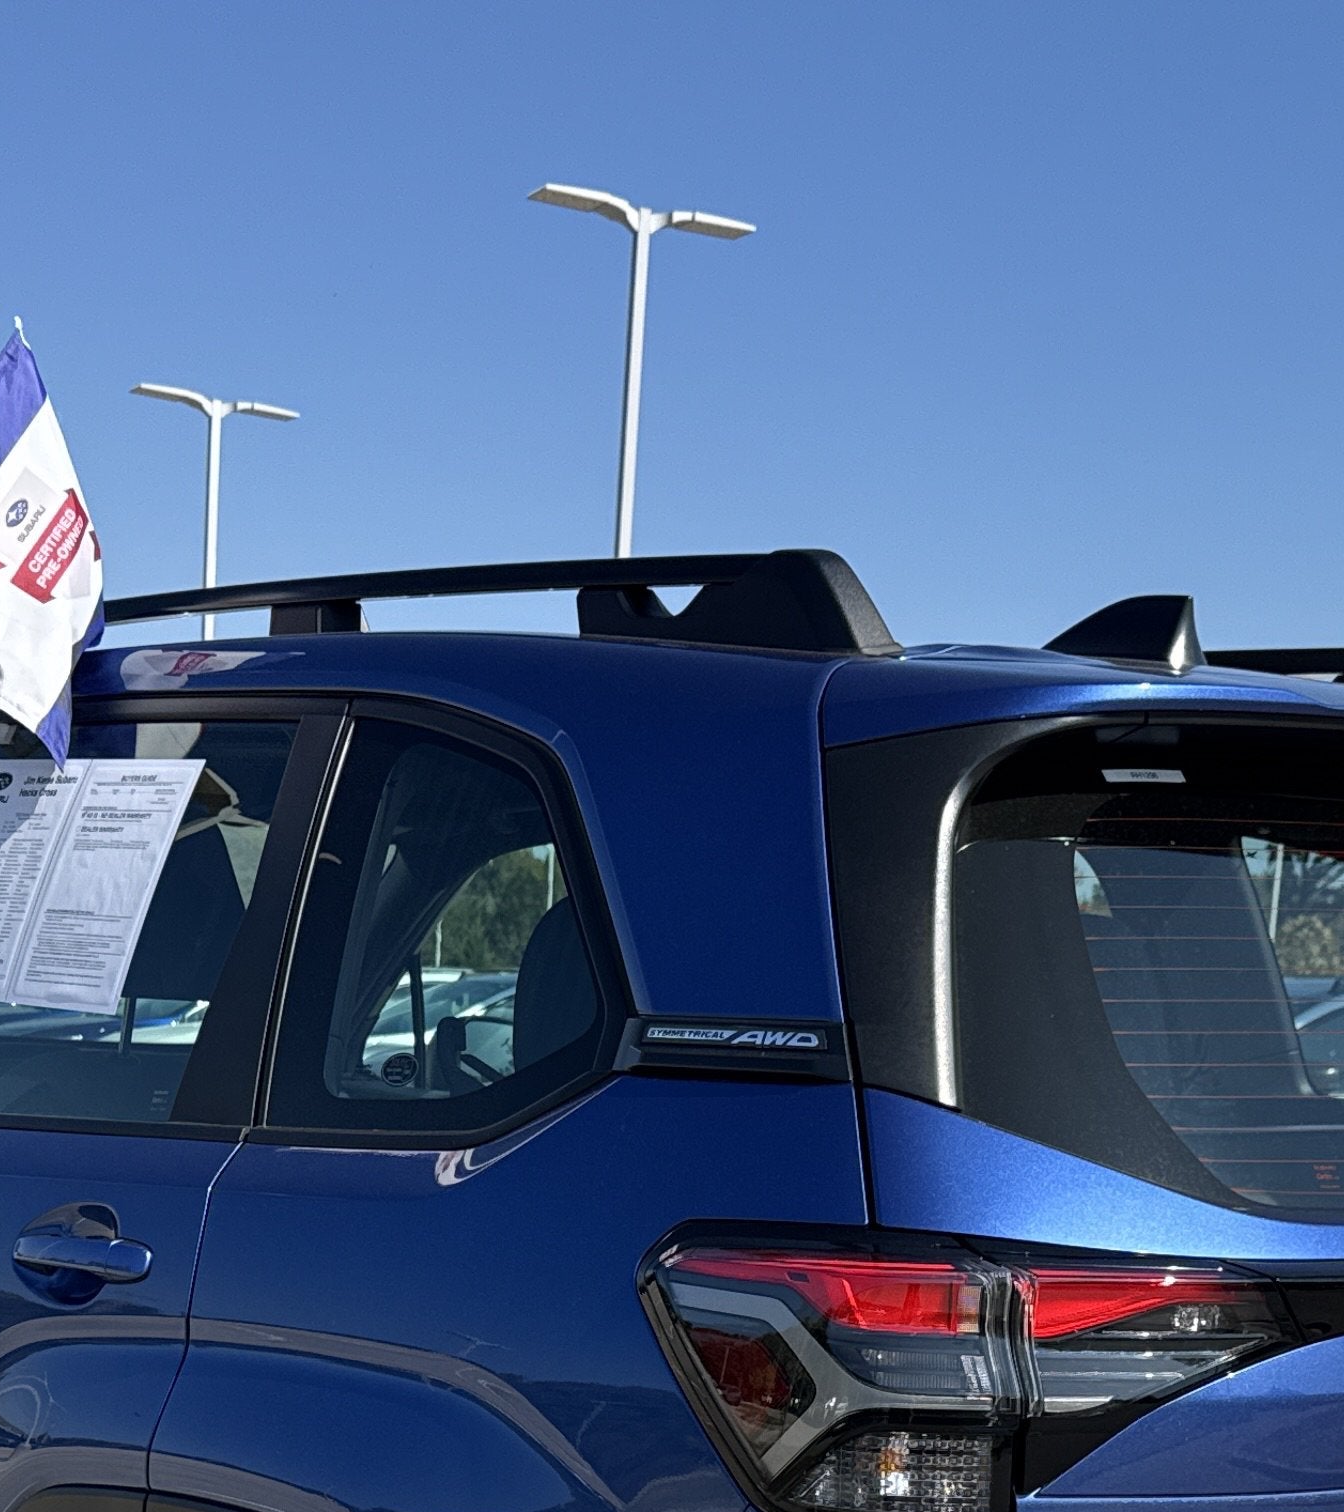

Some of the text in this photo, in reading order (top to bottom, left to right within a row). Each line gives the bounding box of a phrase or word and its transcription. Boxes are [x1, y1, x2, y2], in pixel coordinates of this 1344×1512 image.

[17, 504, 46, 543] SUBARU
[28, 507, 76, 573] CERTIFIED
[649, 1029, 819, 1047] SYMMETRICAL AWD
